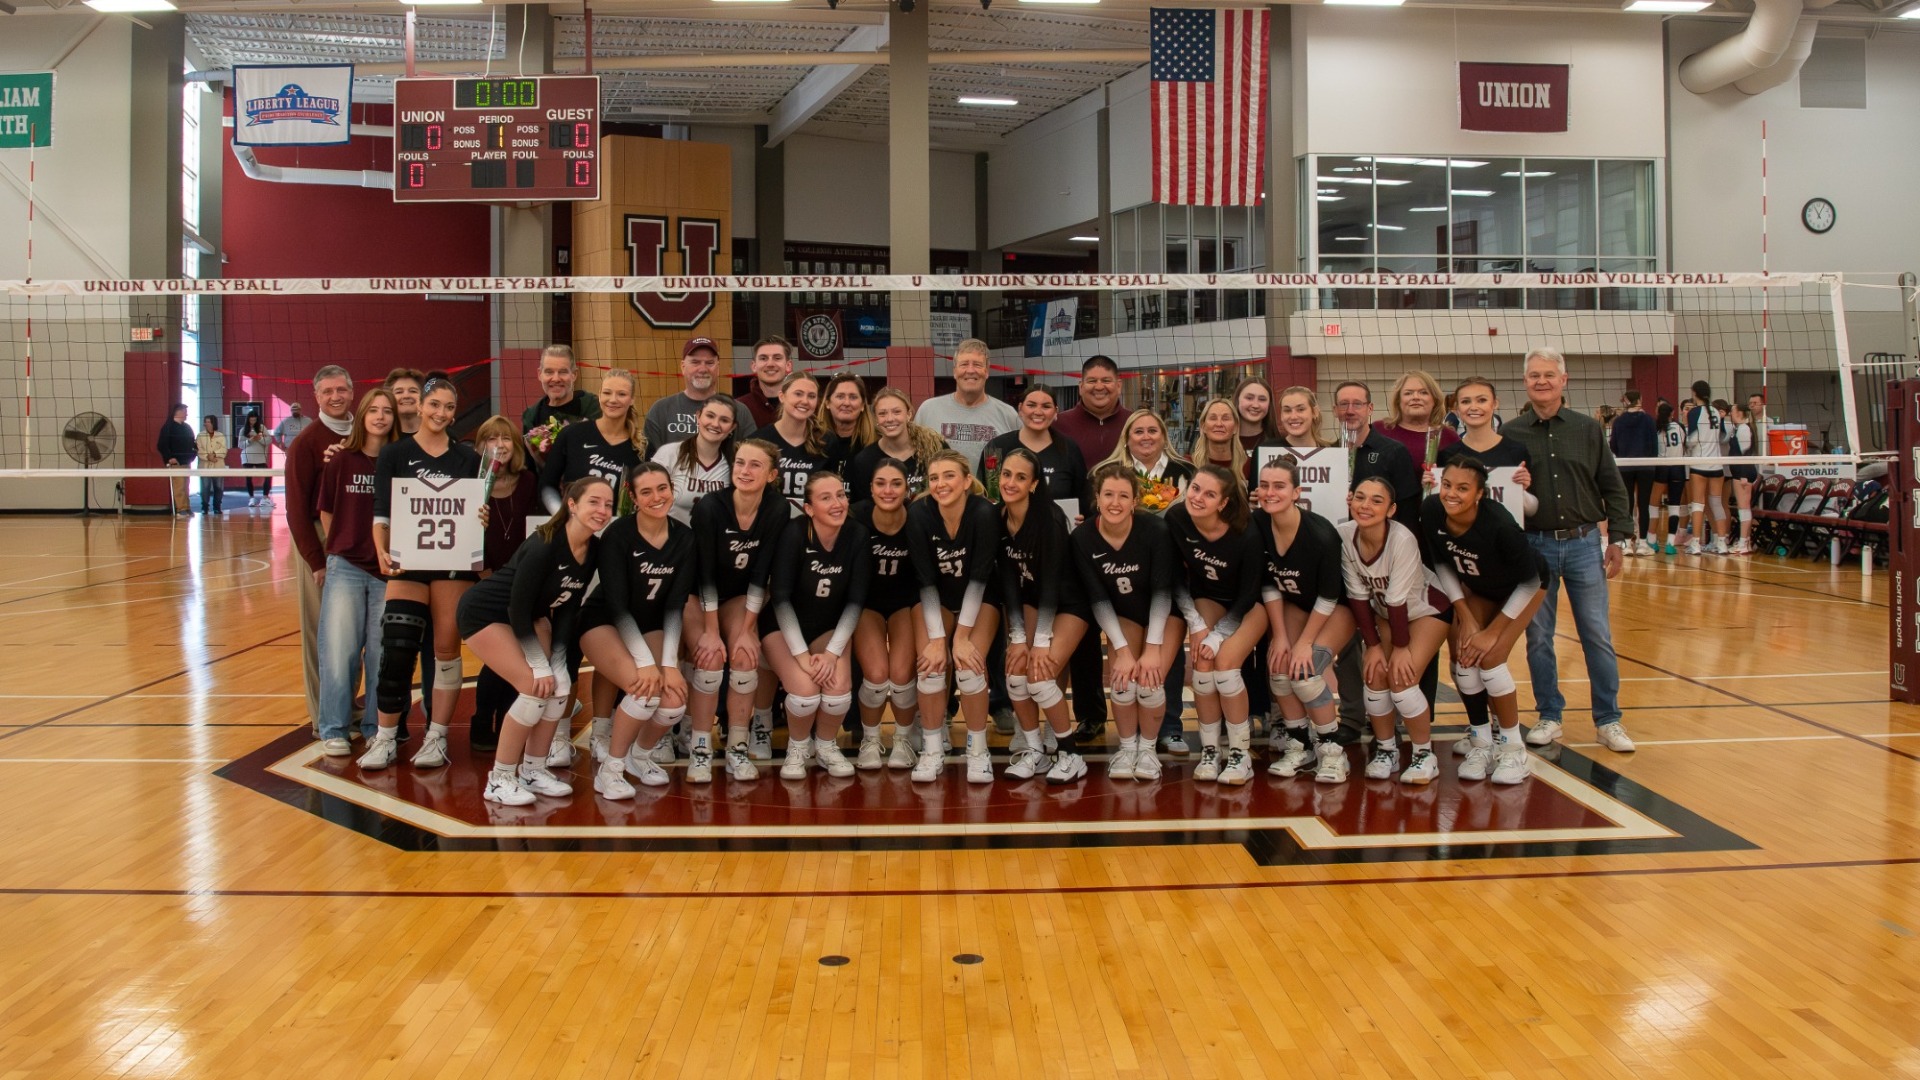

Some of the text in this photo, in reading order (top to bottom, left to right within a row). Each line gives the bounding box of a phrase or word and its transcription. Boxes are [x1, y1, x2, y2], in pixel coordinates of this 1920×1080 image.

[0, 87, 40, 107] IAM
[476, 81, 535, 106] 0:00
[1478, 81, 1550, 108] UNION
[247, 98, 338, 111] LIBERTY LEAGUE
[401, 111, 445, 122] UNION
[478, 115, 514, 123] PERIOD
[546, 109, 594, 120] GUEST
[453, 126, 475, 134] POSS
[516, 125, 539, 133] POSS
[575, 123, 589, 147] 0
[427, 125, 441, 150] 0
[499, 125, 503, 148] 1
[511, 139, 539, 147] BONUS
[453, 140, 480, 148] BONUS
[398, 153, 429, 161] FOULS
[471, 151, 538, 160] PLAYER FOUL
[563, 150, 594, 159] FOULS
[410, 163, 424, 187] 0
[575, 161, 589, 185] 0
[624, 214, 720, 330] U
[1539, 273, 1729, 284] UNION VOLLEYBALL
[84, 279, 283, 292] UNION VOLLEYBALL
[321, 279, 331, 290] U
[370, 278, 575, 290] UNION VOLLEYBALL
[613, 278, 624, 289] U
[663, 276, 873, 289] UNION VOLLEYBALL
[912, 276, 922, 286] U
[962, 275, 1169, 287] UNION VOLLEYBALL
[1207, 275, 1217, 285] U
[1256, 273, 1456, 285] UNION VOLLEYBALL
[1493, 274, 1502, 284] U
[1326, 324, 1339, 336] EXIT
[1666, 432, 1679, 447] 19
[1791, 436, 1803, 449] G
[589, 454, 623, 472] Union
[779, 457, 813, 470] Union
[1299, 467, 1331, 484] ION
[1791, 468, 1838, 476] GATORADE
[353, 474, 374, 484] UNI
[688, 477, 725, 493] UNION
[782, 472, 808, 495] 19
[907, 474, 923, 484] ion
[410, 498, 466, 515] UNION
[417, 519, 456, 549] 23
[872, 544, 908, 557] Union
[937, 547, 966, 559] Union
[1447, 541, 1479, 560] Union
[1193, 548, 1227, 568] Union
[640, 562, 674, 574] Union
[811, 560, 843, 575] Union
[878, 559, 899, 575] 11
[938, 559, 963, 577] 21
[1102, 562, 1140, 575] Union
[1267, 562, 1300, 577] Union
[1453, 556, 1480, 576] 13
[1204, 565, 1219, 581] 3
[560, 576, 585, 589] Union
[815, 578, 831, 597] 6
[1116, 577, 1133, 594] 8
[1274, 577, 1301, 594] 12
[646, 579, 662, 600] 7
[550, 591, 572, 607] 2
[1894, 662, 1905, 685] U
